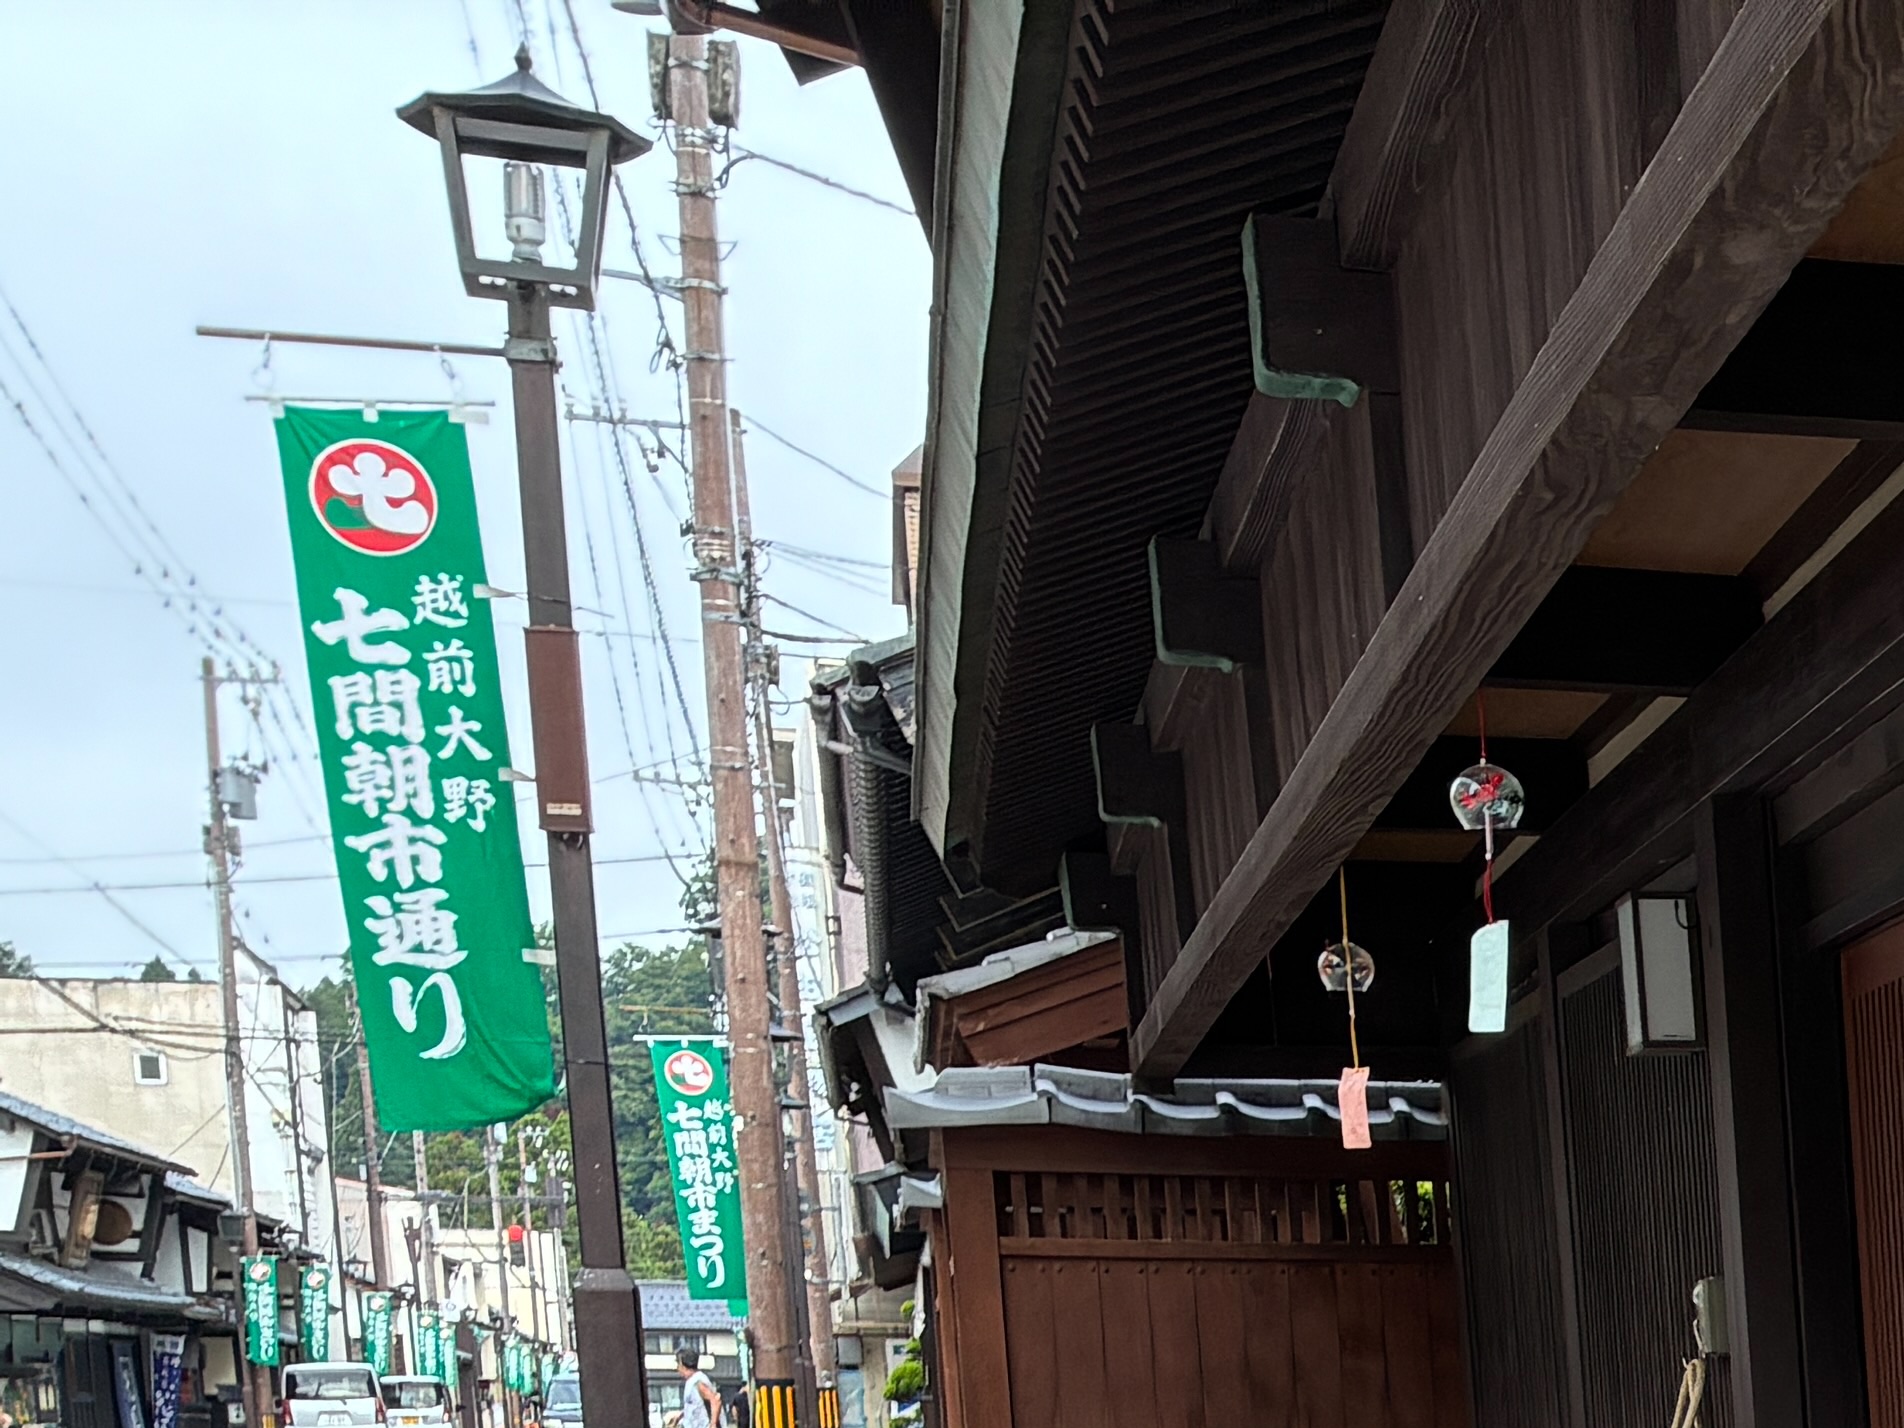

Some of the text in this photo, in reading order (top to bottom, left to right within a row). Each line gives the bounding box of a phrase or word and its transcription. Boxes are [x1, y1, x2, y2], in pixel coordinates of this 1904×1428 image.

[410, 572, 497, 834] 越前大野
[309, 585, 468, 1061] 七間朝市通り
[665, 1100, 726, 1289] 七間朝市まつり
[703, 1098, 735, 1195] 越前大野
